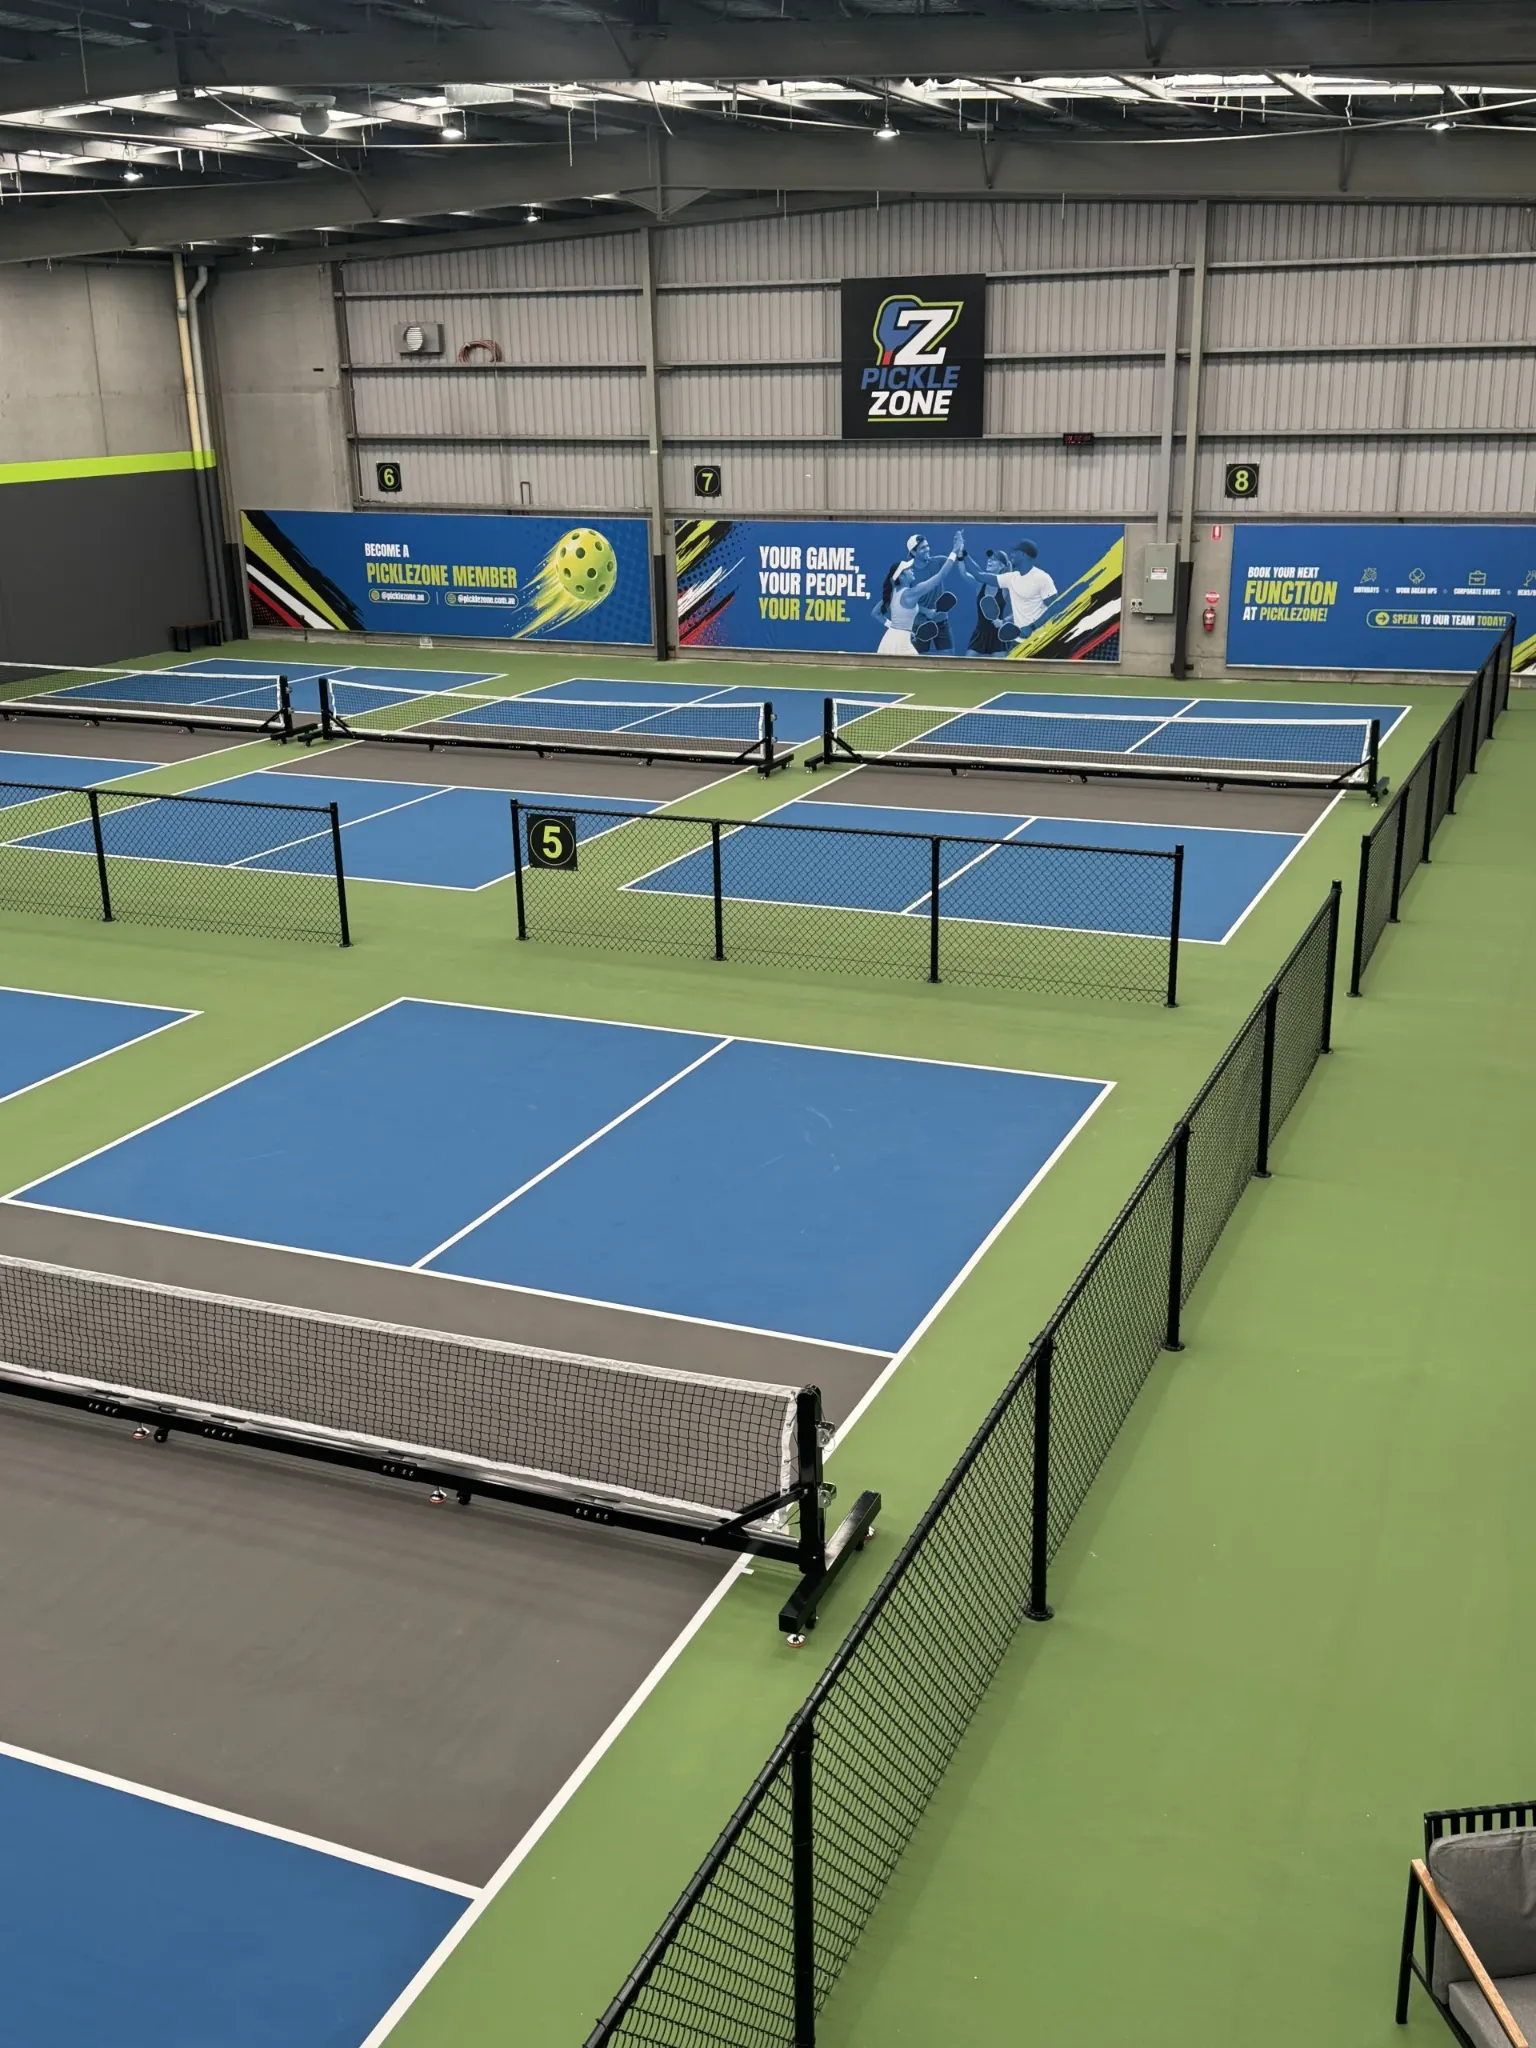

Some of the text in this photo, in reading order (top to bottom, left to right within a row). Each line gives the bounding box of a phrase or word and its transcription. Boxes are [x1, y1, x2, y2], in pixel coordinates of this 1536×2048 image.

[861, 365, 961, 390] PICKLE
[868, 389, 953, 416] ZONE
[384, 468, 395, 487] 6
[702, 472, 713, 492] 7
[1235, 470, 1249, 491] 8
[364, 542, 410, 558] BECOME A
[759, 545, 860, 574] YOUR GAME,
[366, 562, 518, 589] PICKLEZONE MEMBER
[1247, 566, 1320, 579] BOOK YOUR NEXT
[759, 571, 871, 600] YOUR PEOPLE,
[1244, 580, 1339, 606] FUNCTION
[758, 597, 851, 622] YOUR ZONE.
[1242, 606, 1329, 622] AT PICKLEZONE!
[1392, 613, 1507, 627] SPEAK TO OUR TEAM TODAY!
[542, 825, 563, 859] 5
